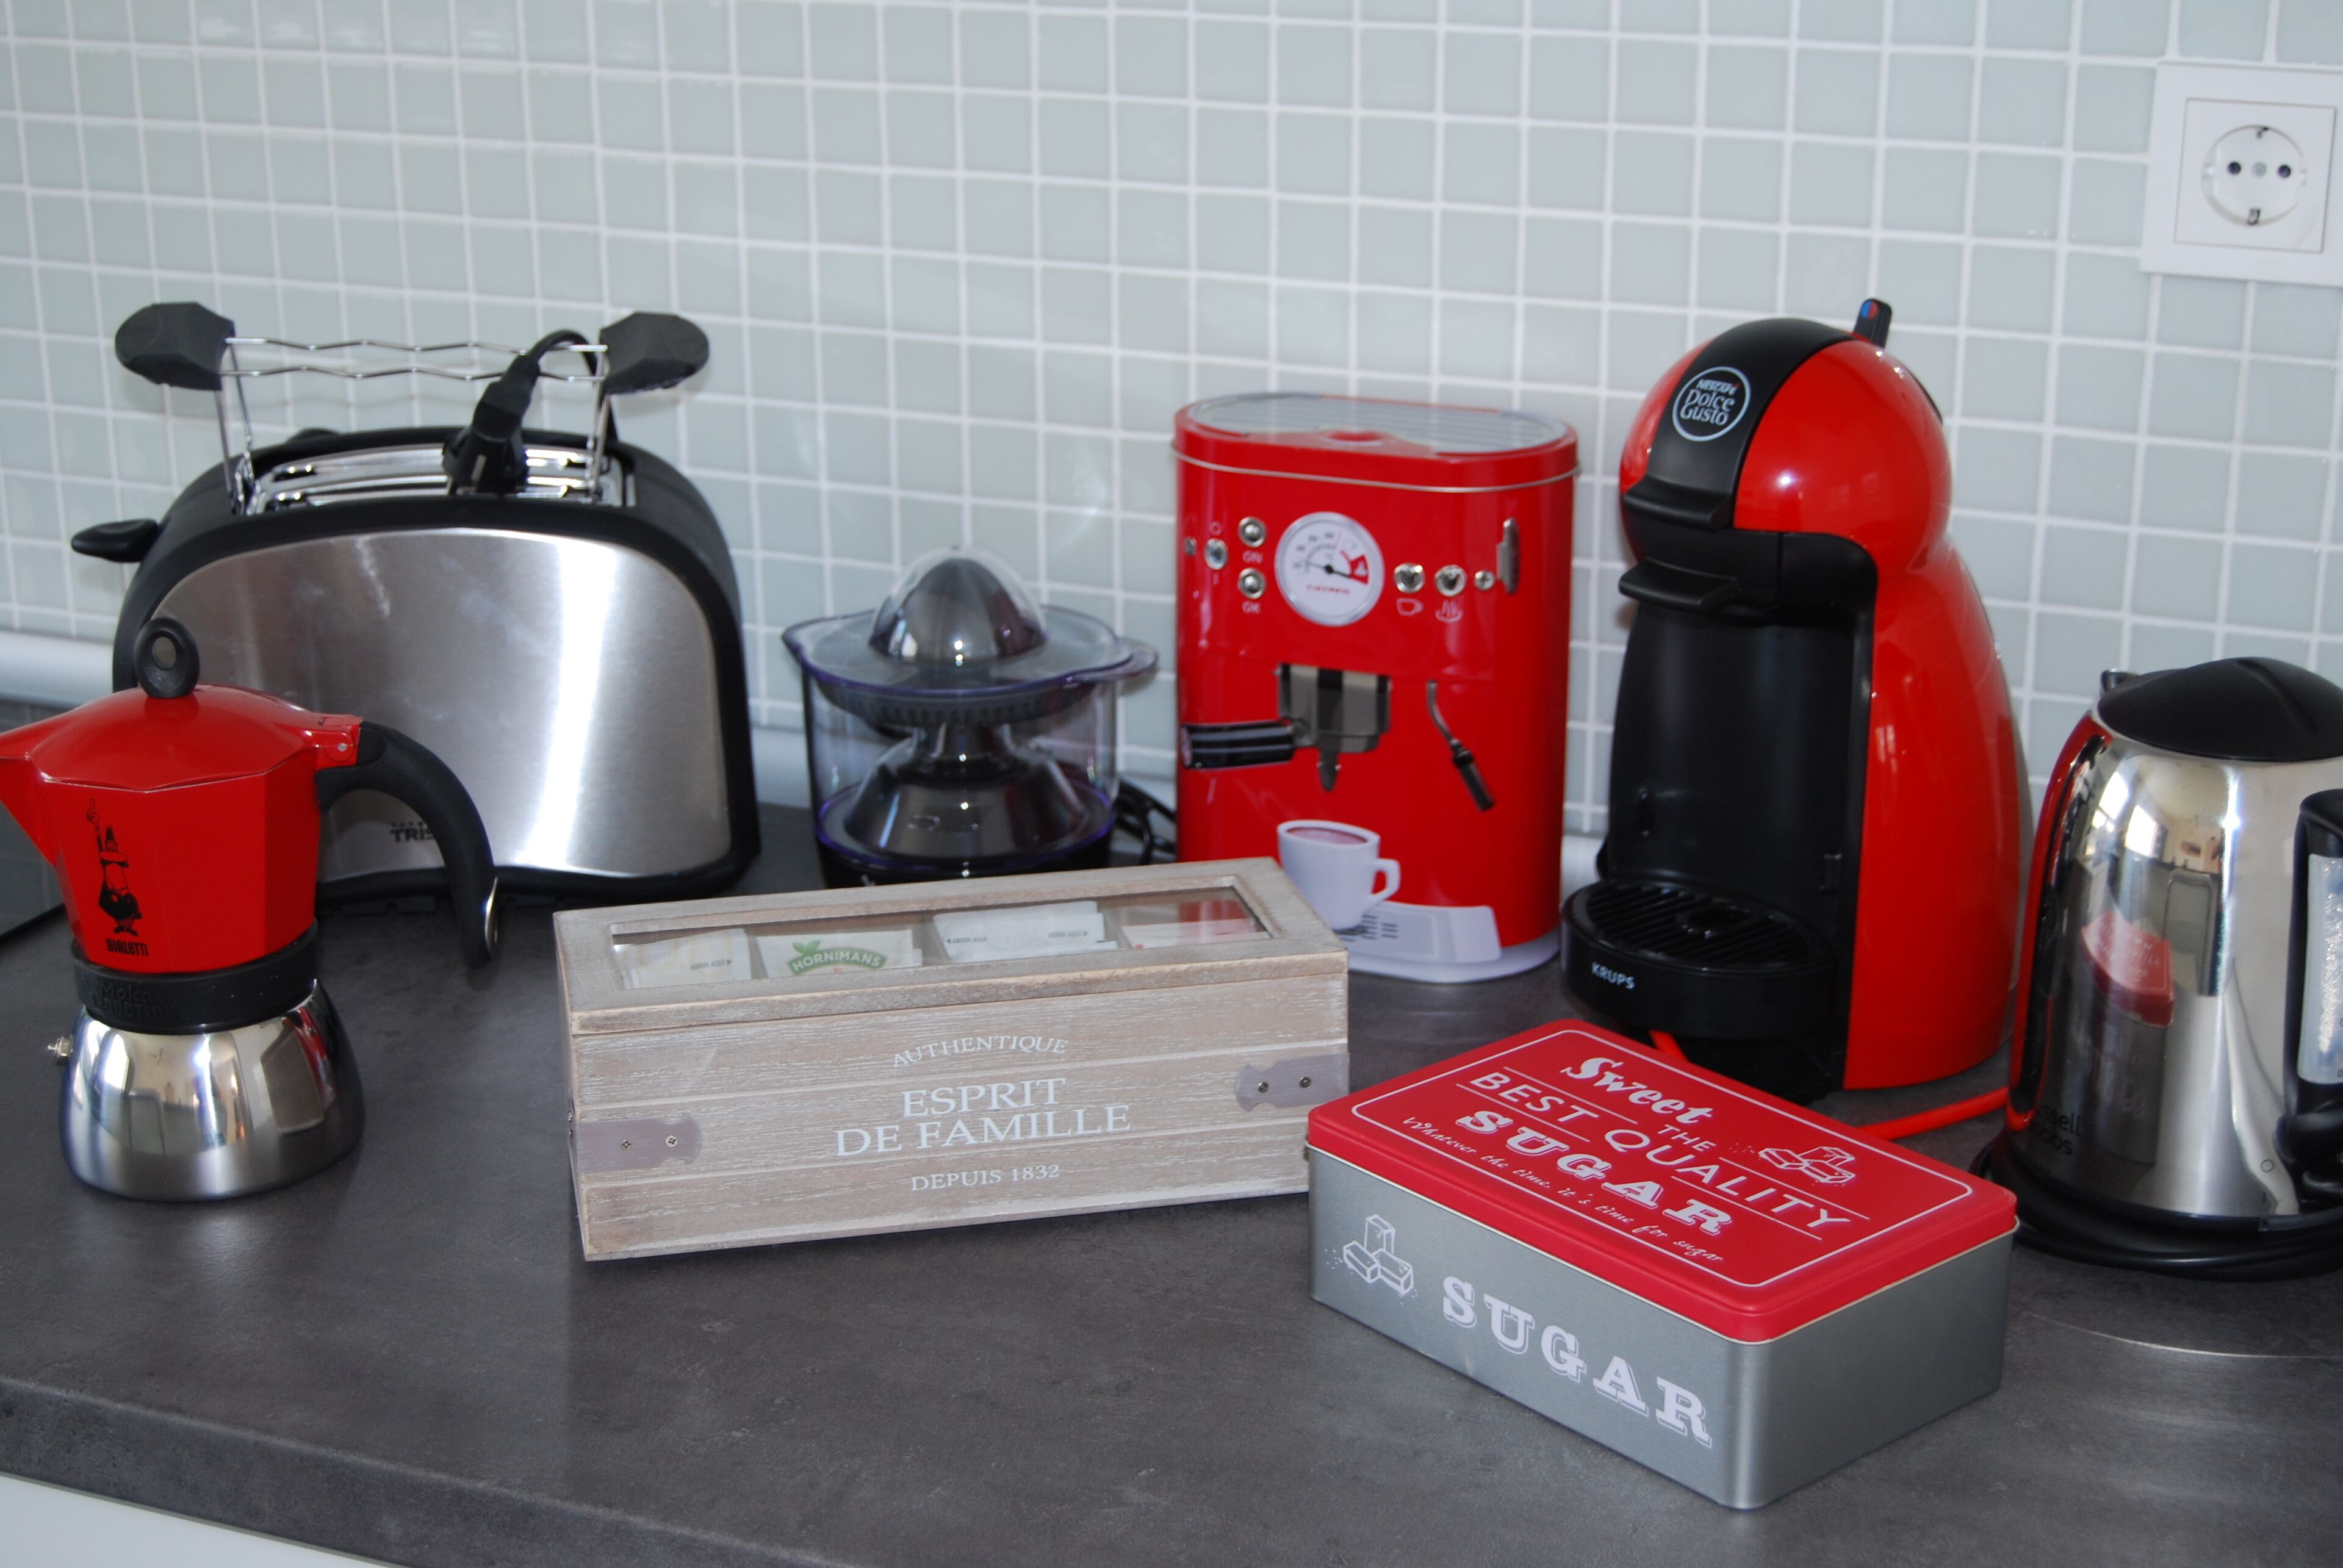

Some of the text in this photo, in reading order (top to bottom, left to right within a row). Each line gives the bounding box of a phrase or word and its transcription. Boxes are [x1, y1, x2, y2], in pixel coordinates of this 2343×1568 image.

[1680, 405, 1729, 426] Gusto
[1685, 389, 1735, 412] Dolce
[106, 938, 149, 957] BIALETTI
[792, 950, 882, 973] HORNIMANS
[1592, 962, 1636, 990] KRUPS
[894, 1035, 1068, 1068] AUTHENTIQUE
[901, 1078, 1066, 1117] ESPRIT
[1560, 1057, 1713, 1125] Sweet
[835, 1105, 1131, 1157] DE FAMILLE
[1657, 1124, 1716, 1152] THE
[1469, 1071, 1851, 1228] BEST QUALITY
[911, 1164, 1059, 1190] DEPUIS 1832
[1455, 1110, 1733, 1236] SUGAR
[1403, 1117, 1477, 1154] Whatever
[1480, 1154, 1509, 1168] the
[1594, 1201, 1635, 1224] time
[1632, 1224, 1668, 1238] for
[1672, 1239, 1724, 1263] sugar
[1442, 1276, 1712, 1448] SUGAR
